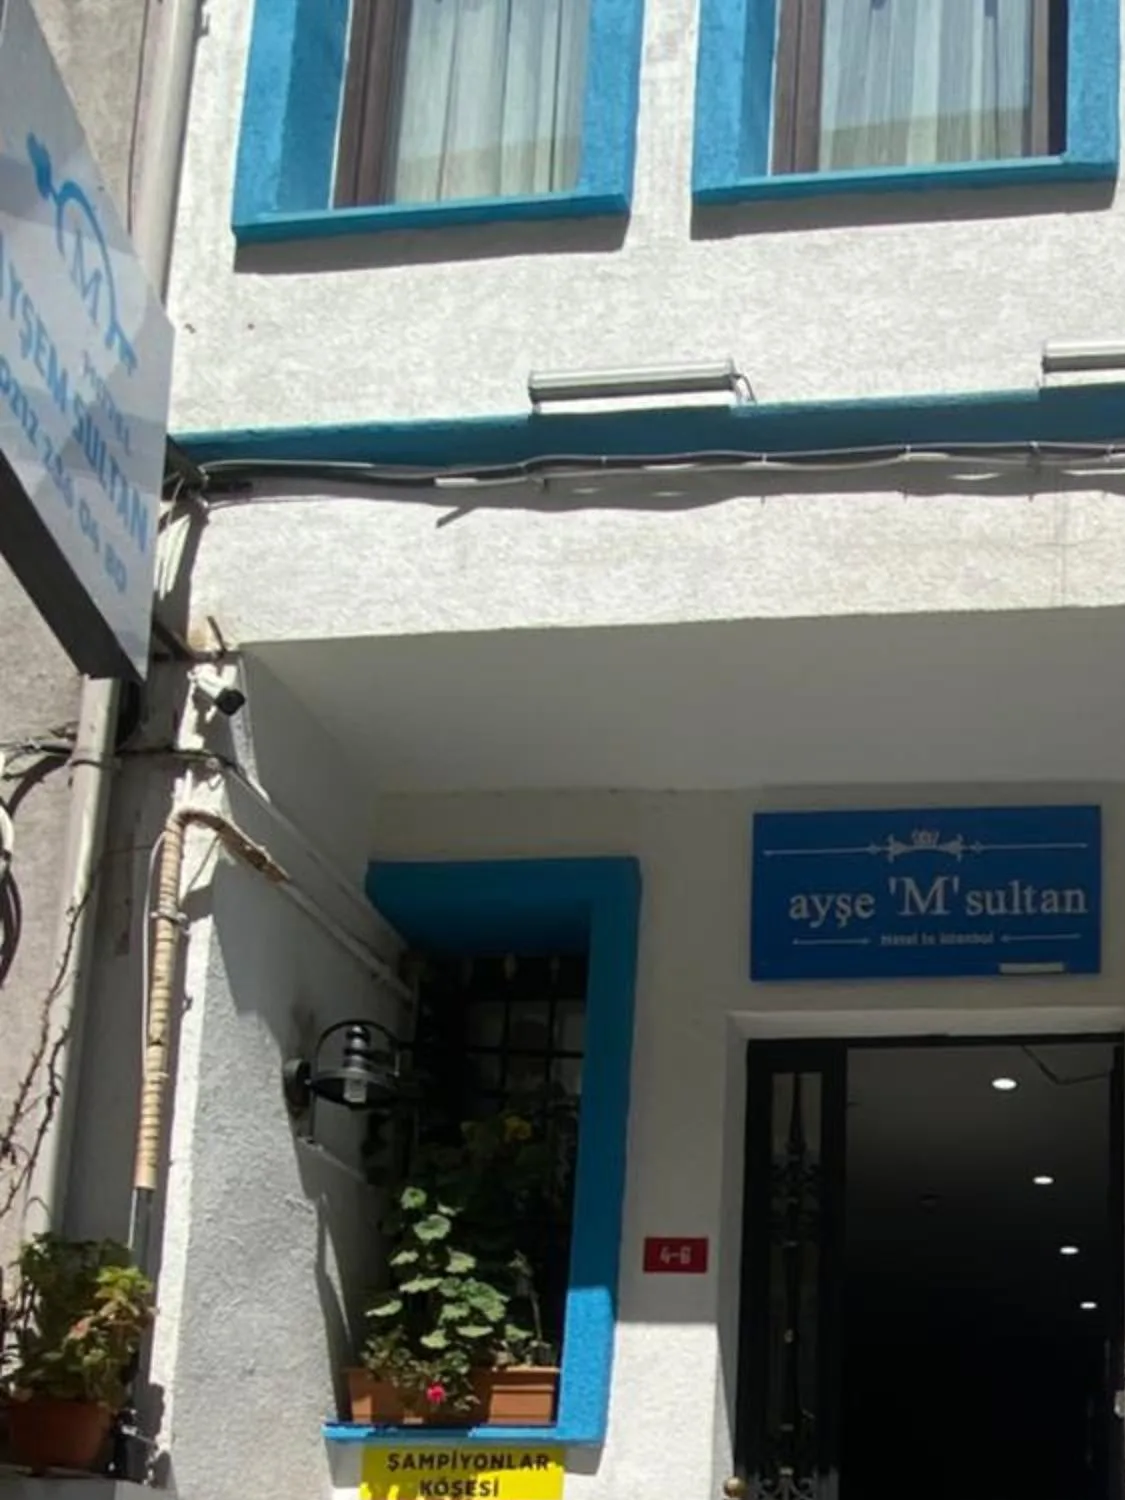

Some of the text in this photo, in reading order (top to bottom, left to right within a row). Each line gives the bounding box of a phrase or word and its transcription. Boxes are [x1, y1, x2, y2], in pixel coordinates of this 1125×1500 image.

[72, 391, 148, 552] SULTAN
[789, 892, 875, 927] ayşe
[965, 880, 1088, 916] sultan
[387, 1451, 550, 1473] ŞAMPİYONLAR
